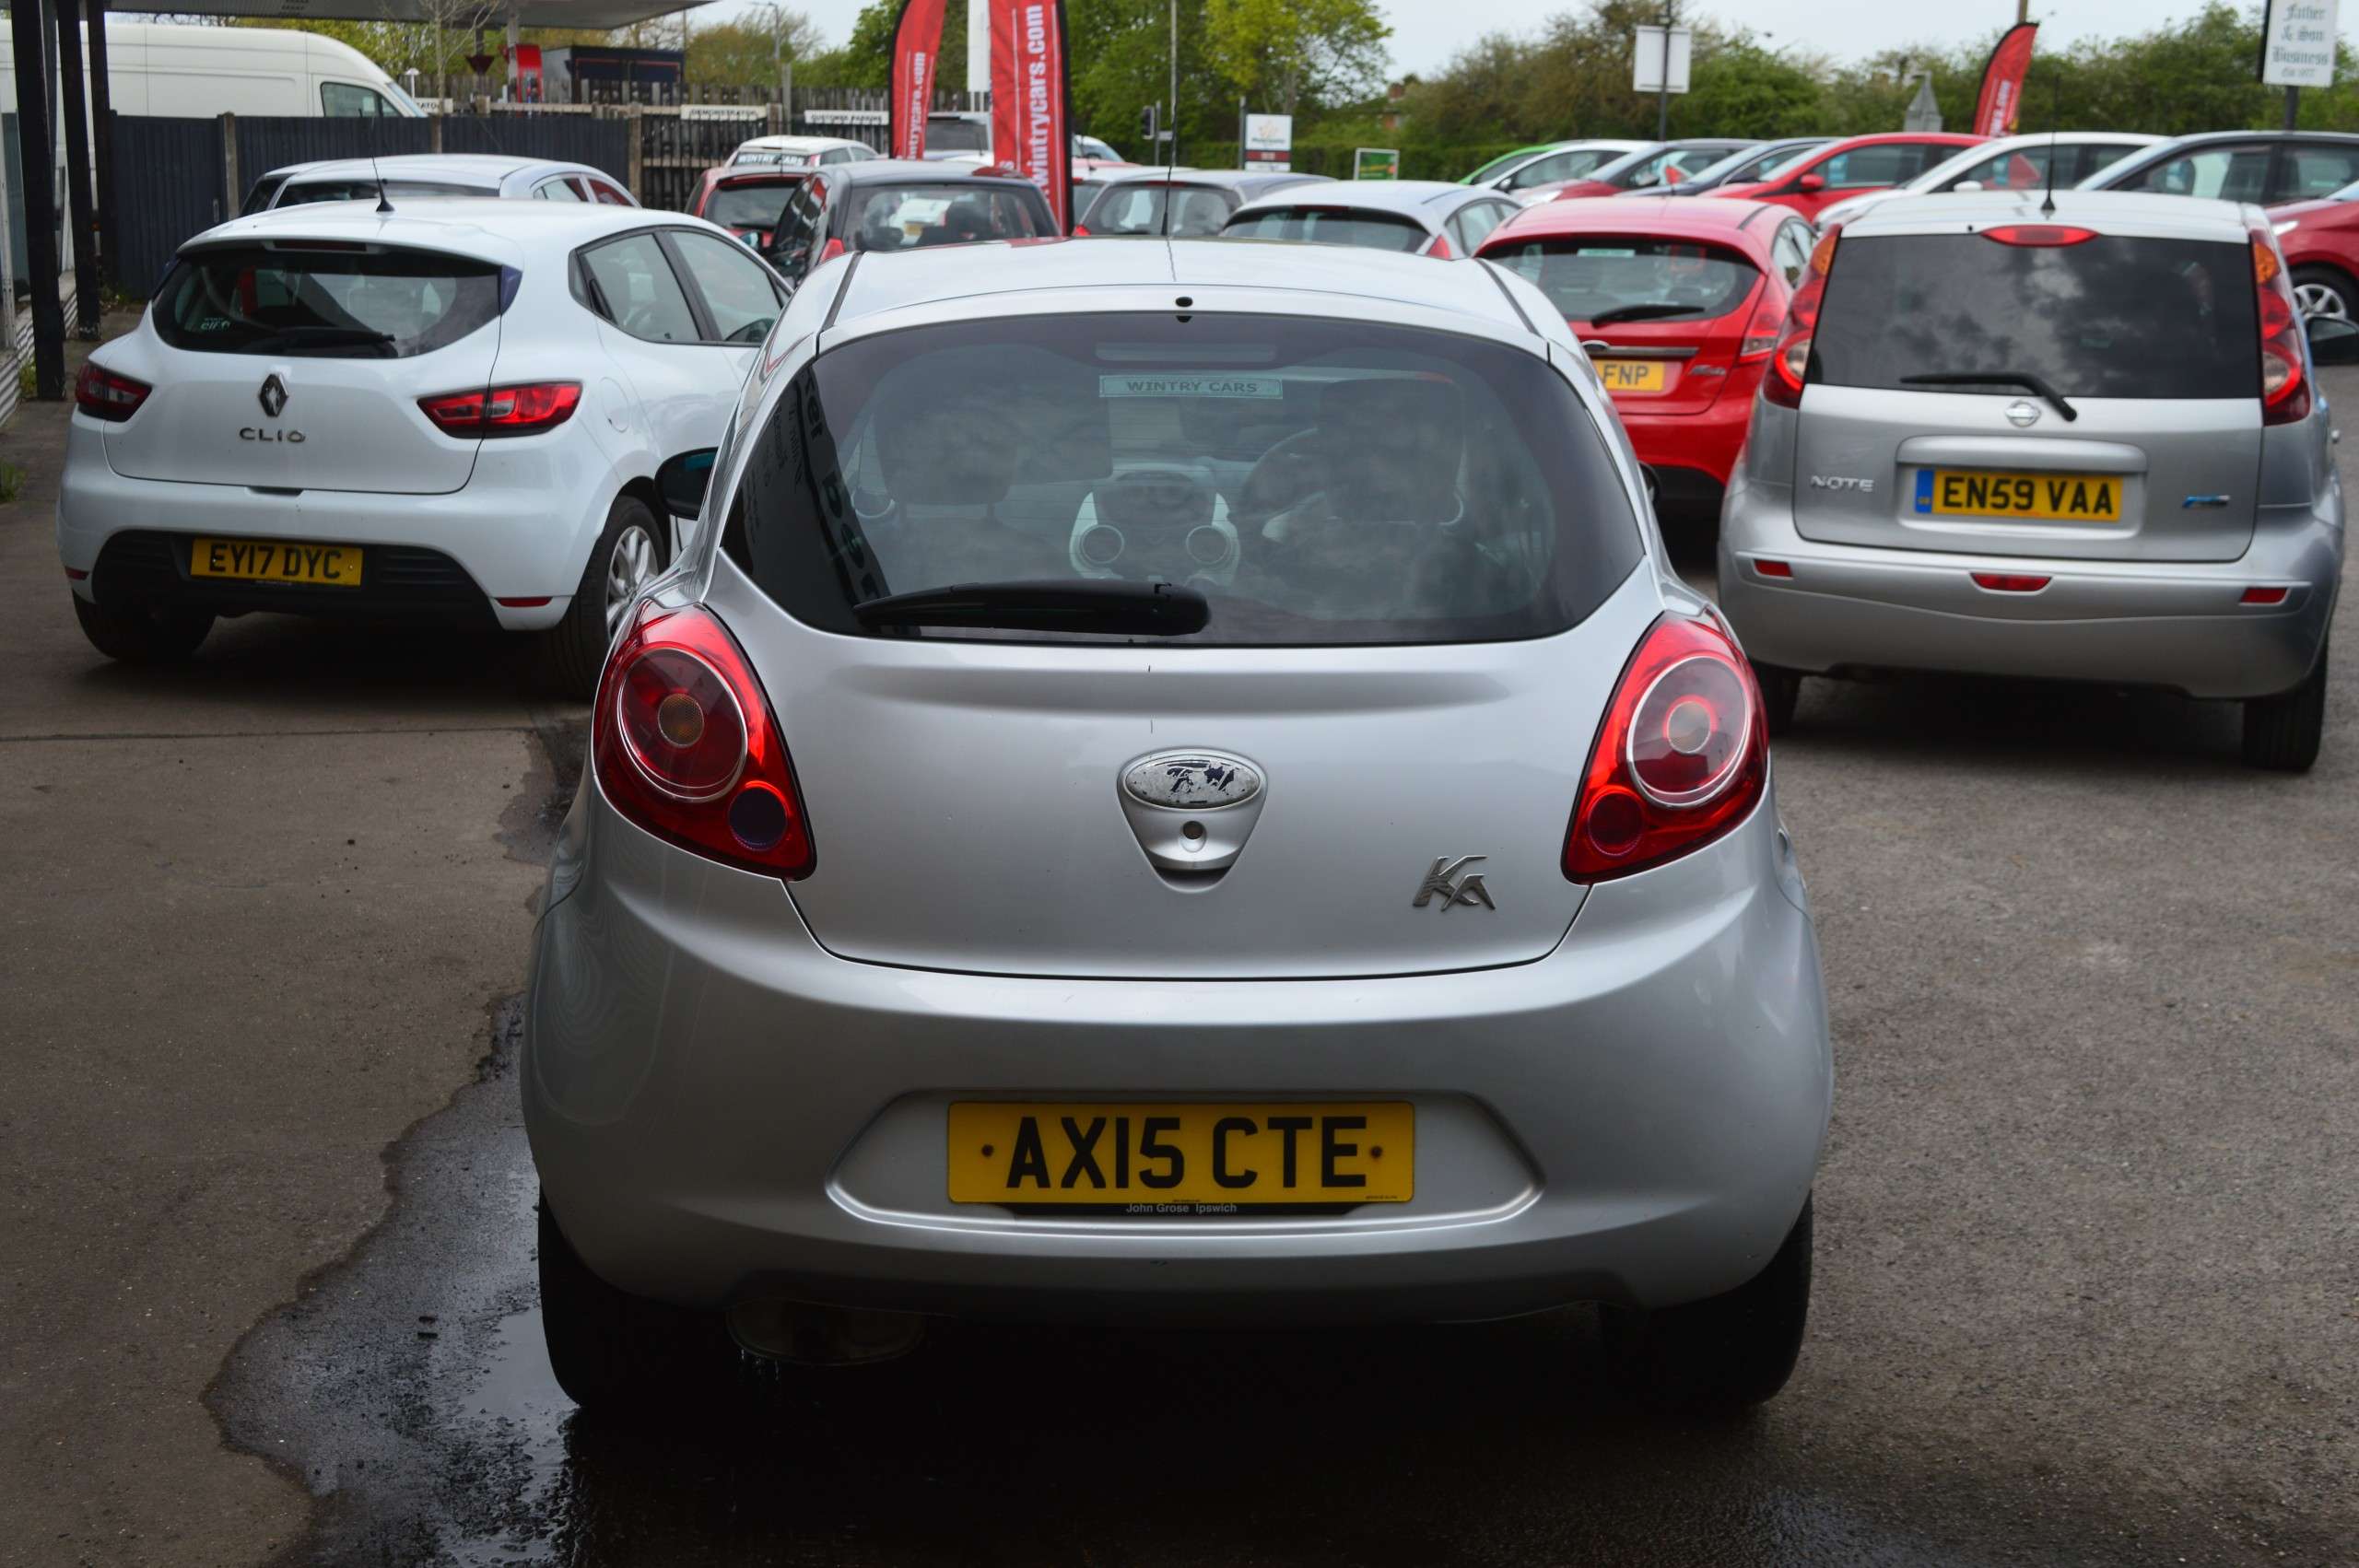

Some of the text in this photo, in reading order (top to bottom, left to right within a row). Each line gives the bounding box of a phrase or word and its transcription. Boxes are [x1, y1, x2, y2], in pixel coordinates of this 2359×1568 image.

[1602, 363, 1649, 386] FNP
[1126, 380, 1259, 393] WINTRY CARS
[239, 427, 306, 443] CLIO
[1809, 474, 1874, 493] NOTE
[1942, 475, 2113, 515] EN59 VAA
[208, 543, 342, 579] EY17 DYC
[1004, 1116, 1367, 1189] AX15 CTE
[1125, 1203, 1238, 1215] John Grose Ipswich
